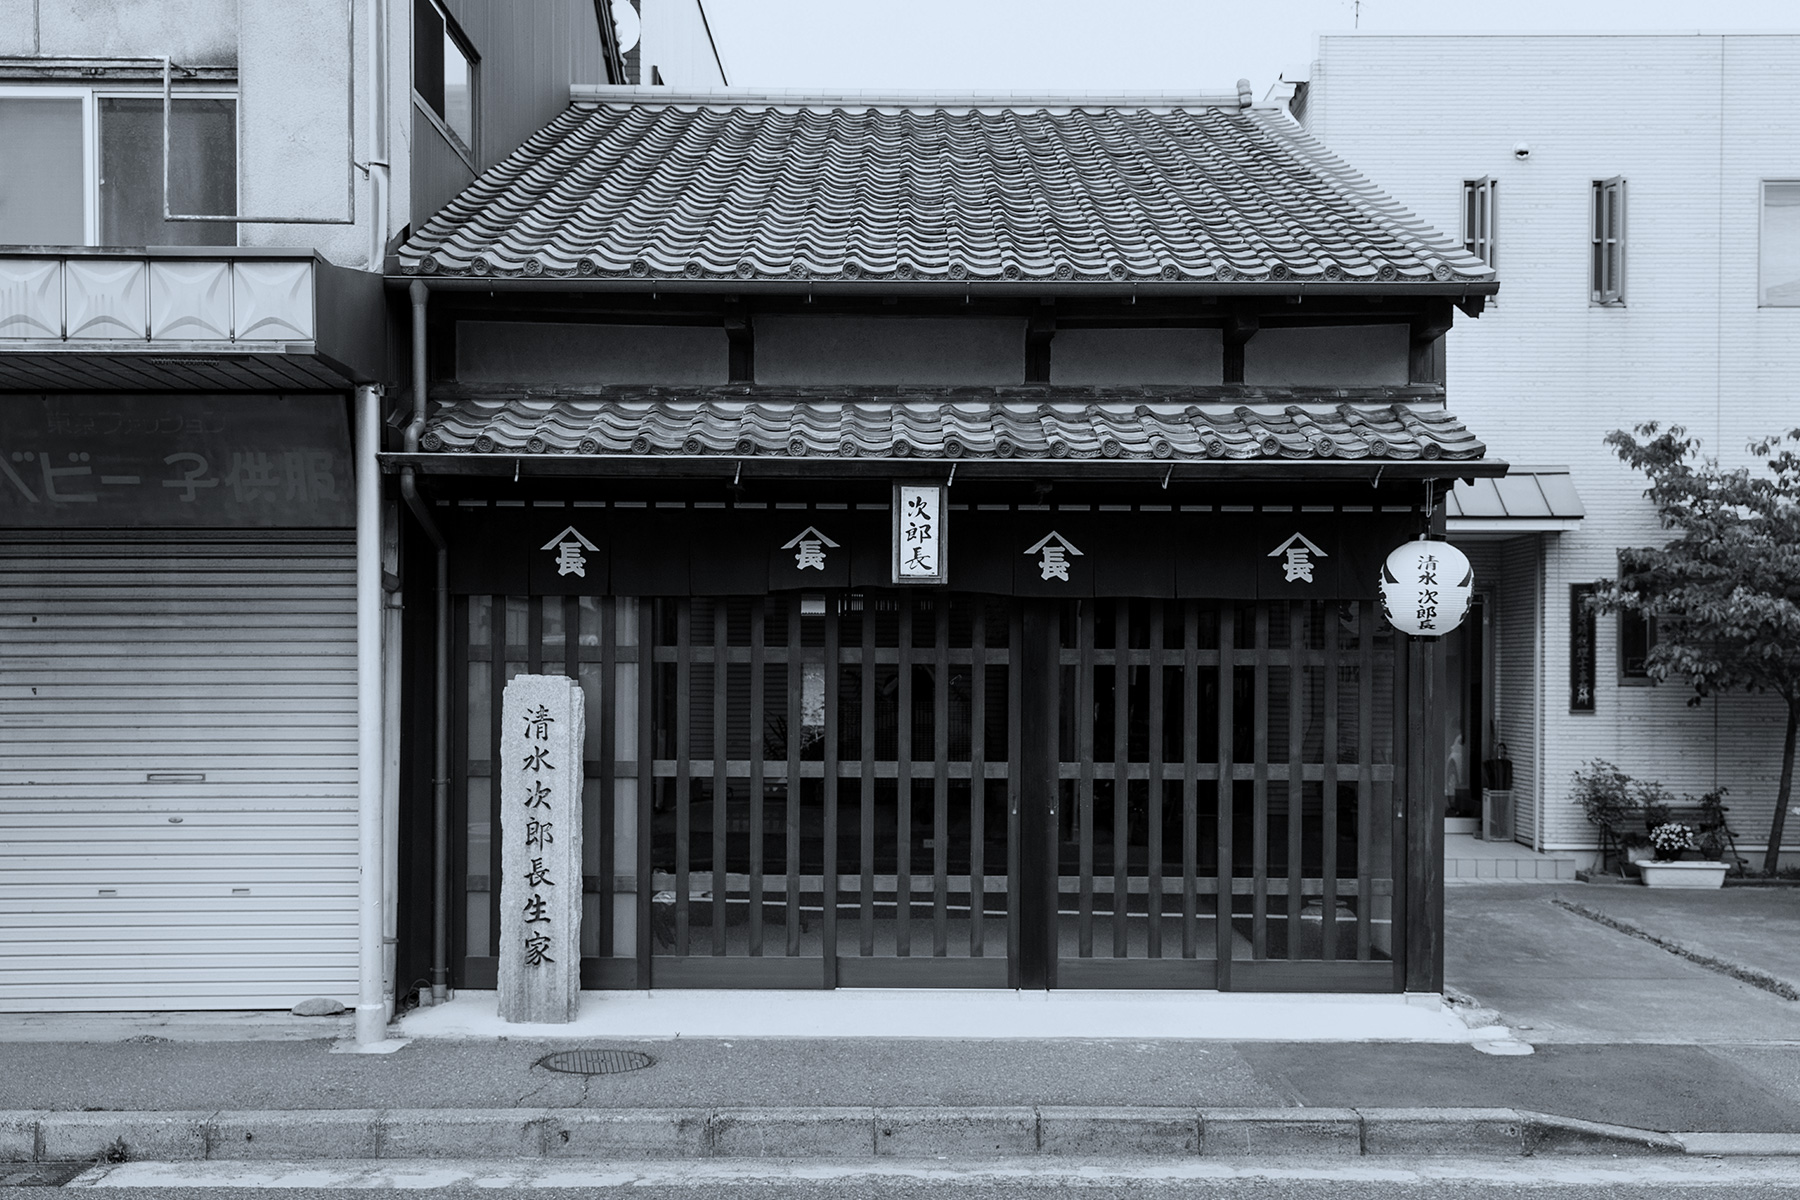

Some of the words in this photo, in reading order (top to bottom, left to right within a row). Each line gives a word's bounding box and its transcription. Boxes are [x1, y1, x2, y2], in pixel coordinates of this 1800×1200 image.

[904, 496, 932, 570] 次郎長
[554, 540, 587, 578] 長
[794, 540, 828, 571] 長
[1037, 545, 1071, 582] 長
[1281, 547, 1316, 584] 長
[1416, 554, 1439, 630] 清水次郎長
[522, 704, 556, 967] 清水次郎長生家
